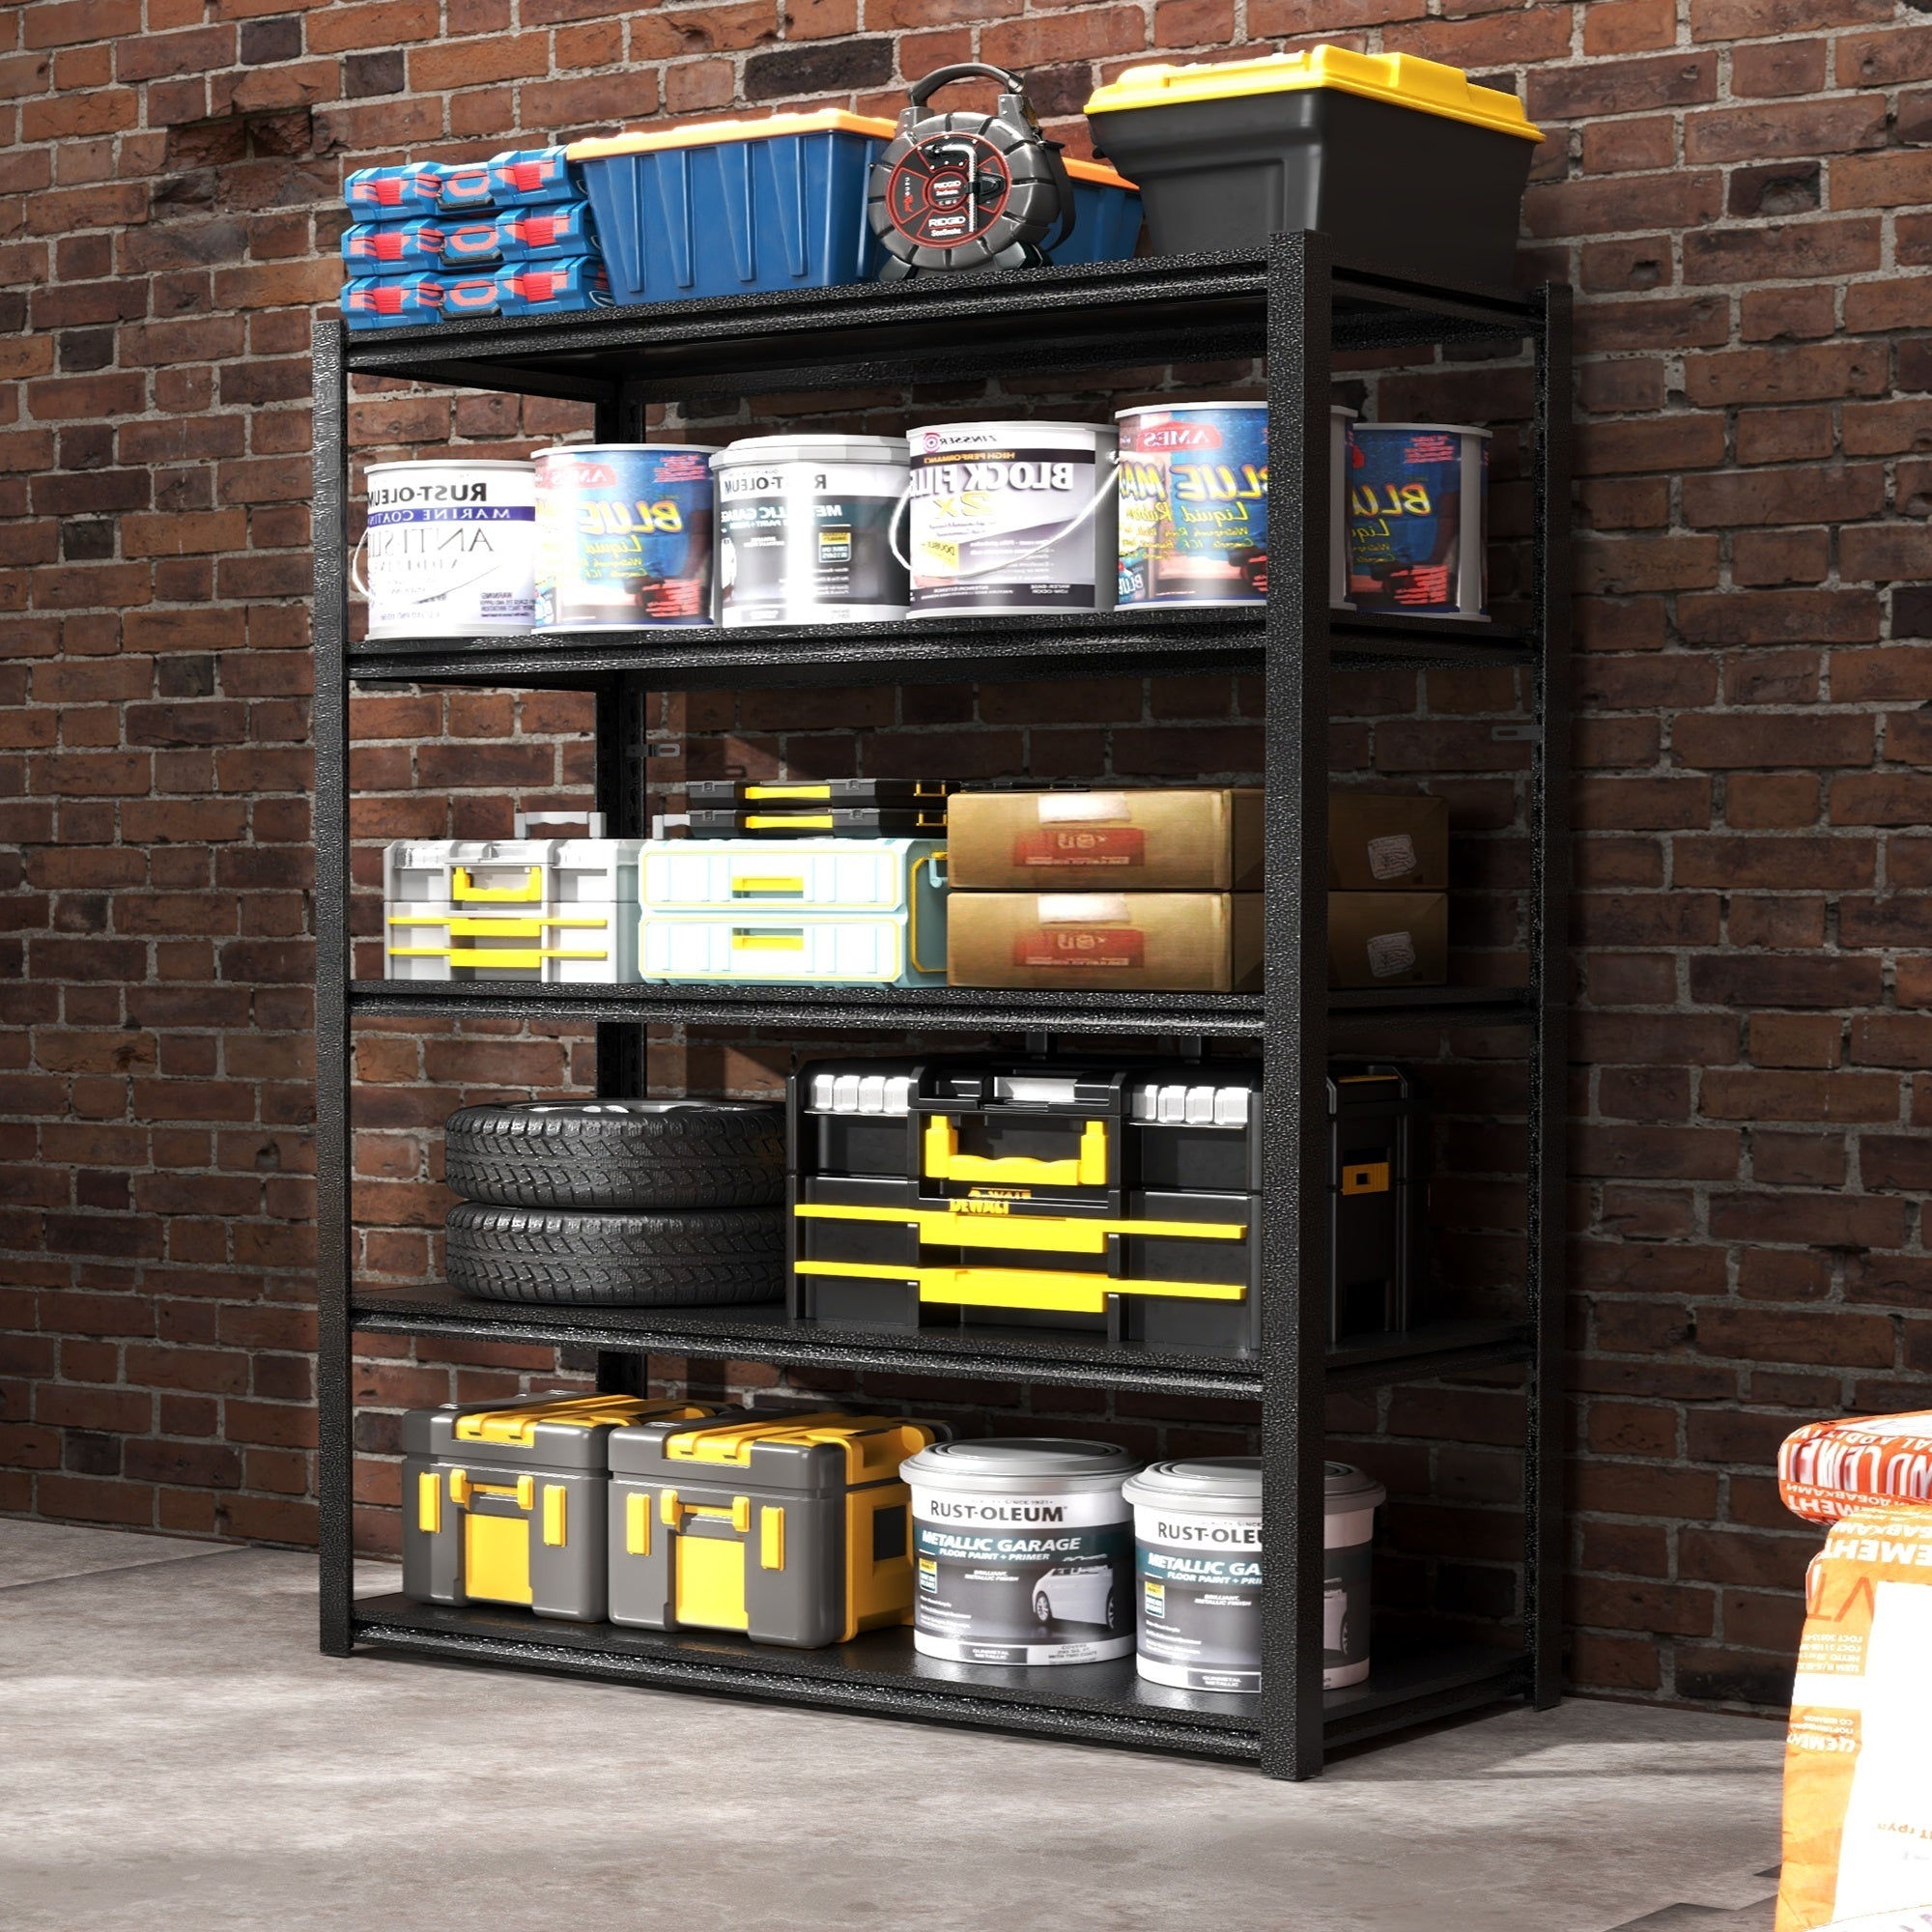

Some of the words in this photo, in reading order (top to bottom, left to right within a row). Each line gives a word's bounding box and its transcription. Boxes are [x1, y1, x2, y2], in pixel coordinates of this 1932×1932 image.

[928, 215, 966, 227] RIDGID
[1790, 1427, 1900, 1446] ADDITIV
[930, 1500, 1064, 1521] RUST-OLEUM
[922, 1529, 994, 1551] METALLIC
[996, 1537, 1082, 1552] GARAGE
[939, 1548, 967, 1558] FLOOR
[968, 1550, 999, 1561] PAINT
[1009, 1552, 1051, 1561] PRIMER
[1824, 1537, 1932, 1567] ЕМЕНТ
[1147, 1551, 1226, 1576] METALLIC
[1167, 1571, 1197, 1582] FLOOR
[1197, 1575, 1231, 1584] PAINT
